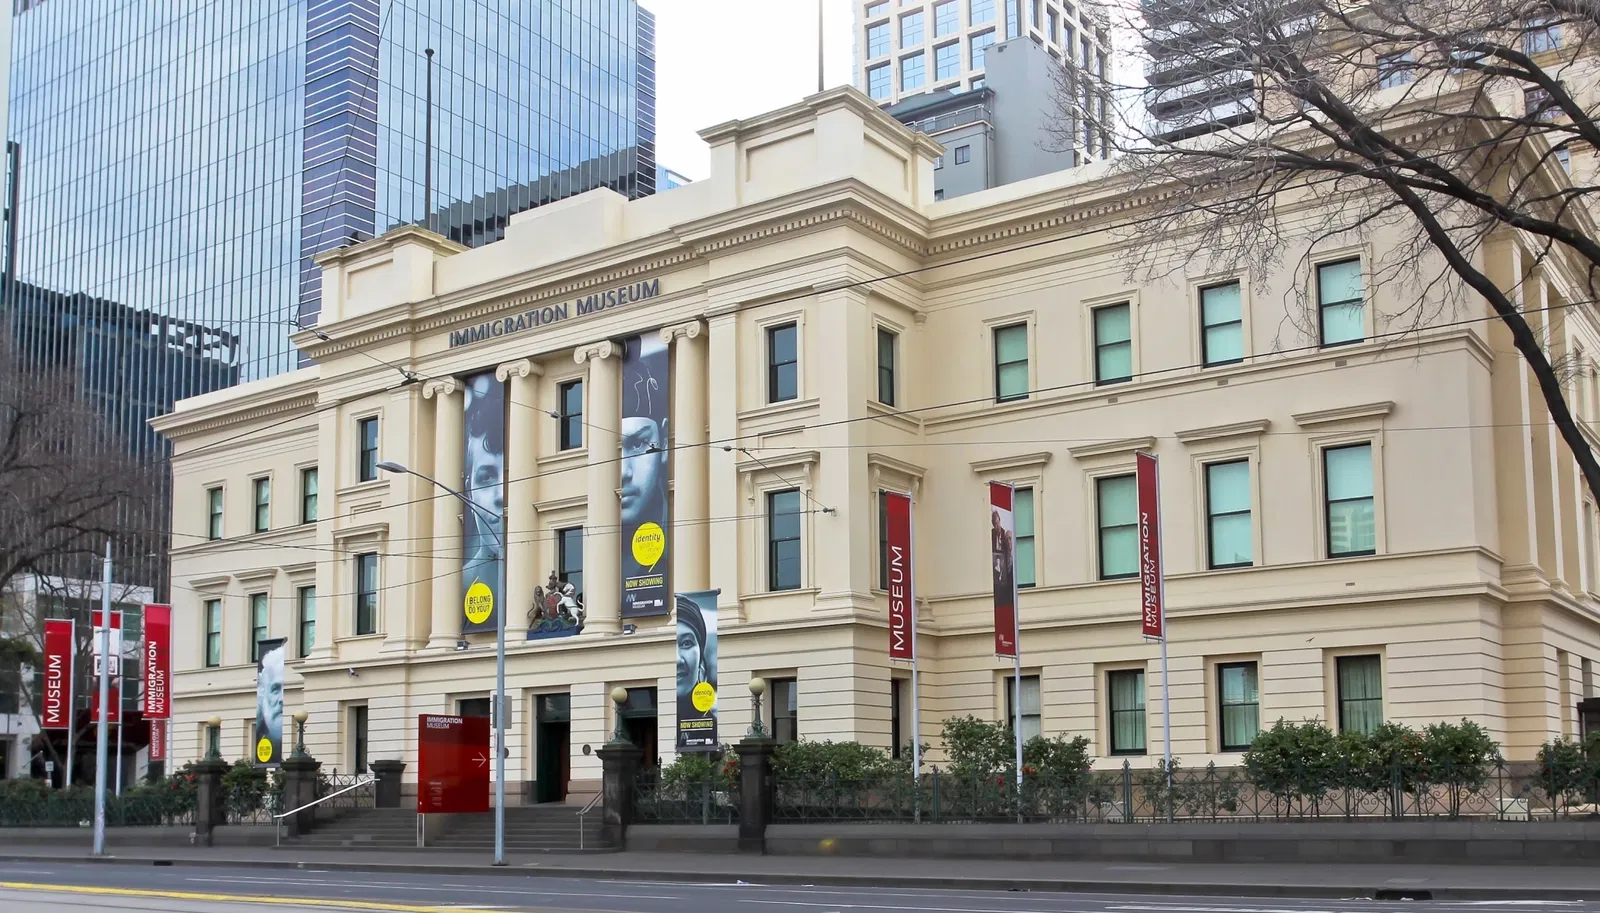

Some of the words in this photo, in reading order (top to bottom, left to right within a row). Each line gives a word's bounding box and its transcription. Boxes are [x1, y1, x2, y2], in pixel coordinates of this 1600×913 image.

[449, 303, 568, 348] IMMIGRATION
[577, 278, 660, 316] MUSEUM
[635, 532, 661, 543] identity
[626, 580, 638, 589] NOW
[638, 577, 663, 587] SHOWING
[1142, 512, 1151, 627] IMMIGRATION
[468, 606, 476, 614] DO
[477, 605, 490, 613] YOU?
[469, 595, 491, 605] BELONG
[891, 546, 904, 651] MUSEUM
[47, 655, 62, 722] MUSEUM
[148, 641, 157, 713] IMMIGRATION
[156, 670, 164, 713] MUSEUM
[426, 716, 463, 724] IMMIGRATION
